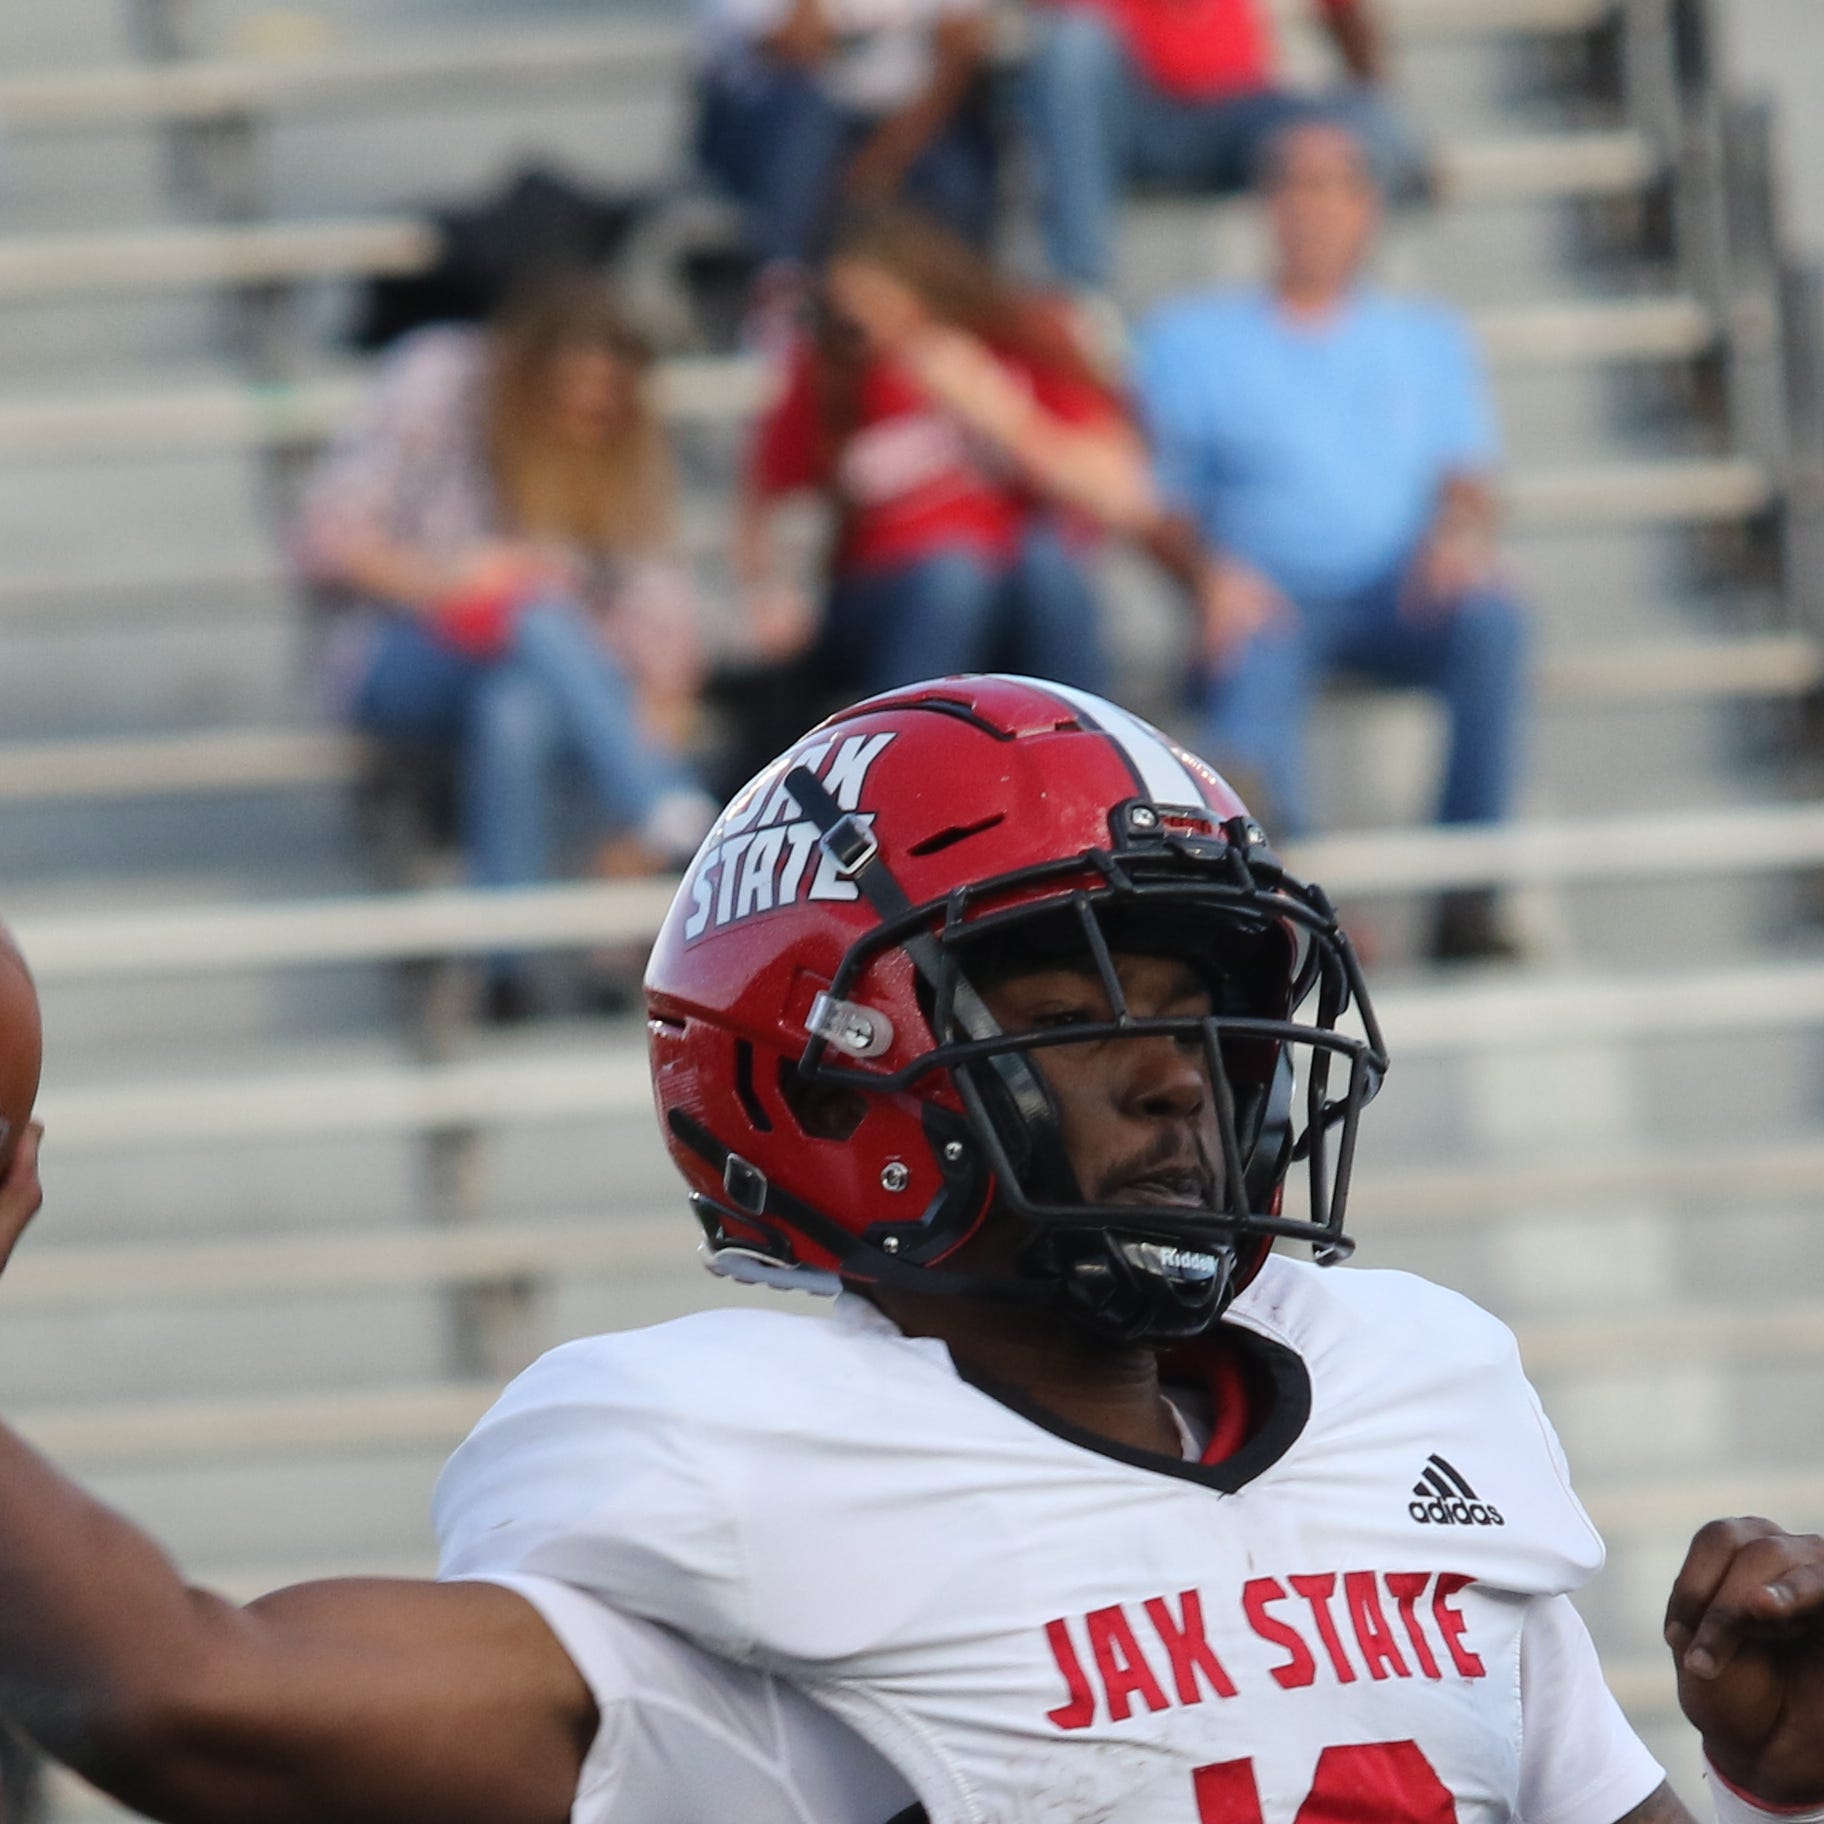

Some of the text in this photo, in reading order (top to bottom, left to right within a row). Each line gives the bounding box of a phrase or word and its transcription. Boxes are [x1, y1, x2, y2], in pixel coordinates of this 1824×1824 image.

[684, 813, 877, 941] STATE
[1407, 1495, 1505, 1527] adidas
[1044, 1570, 1486, 1730] JAX STATE
